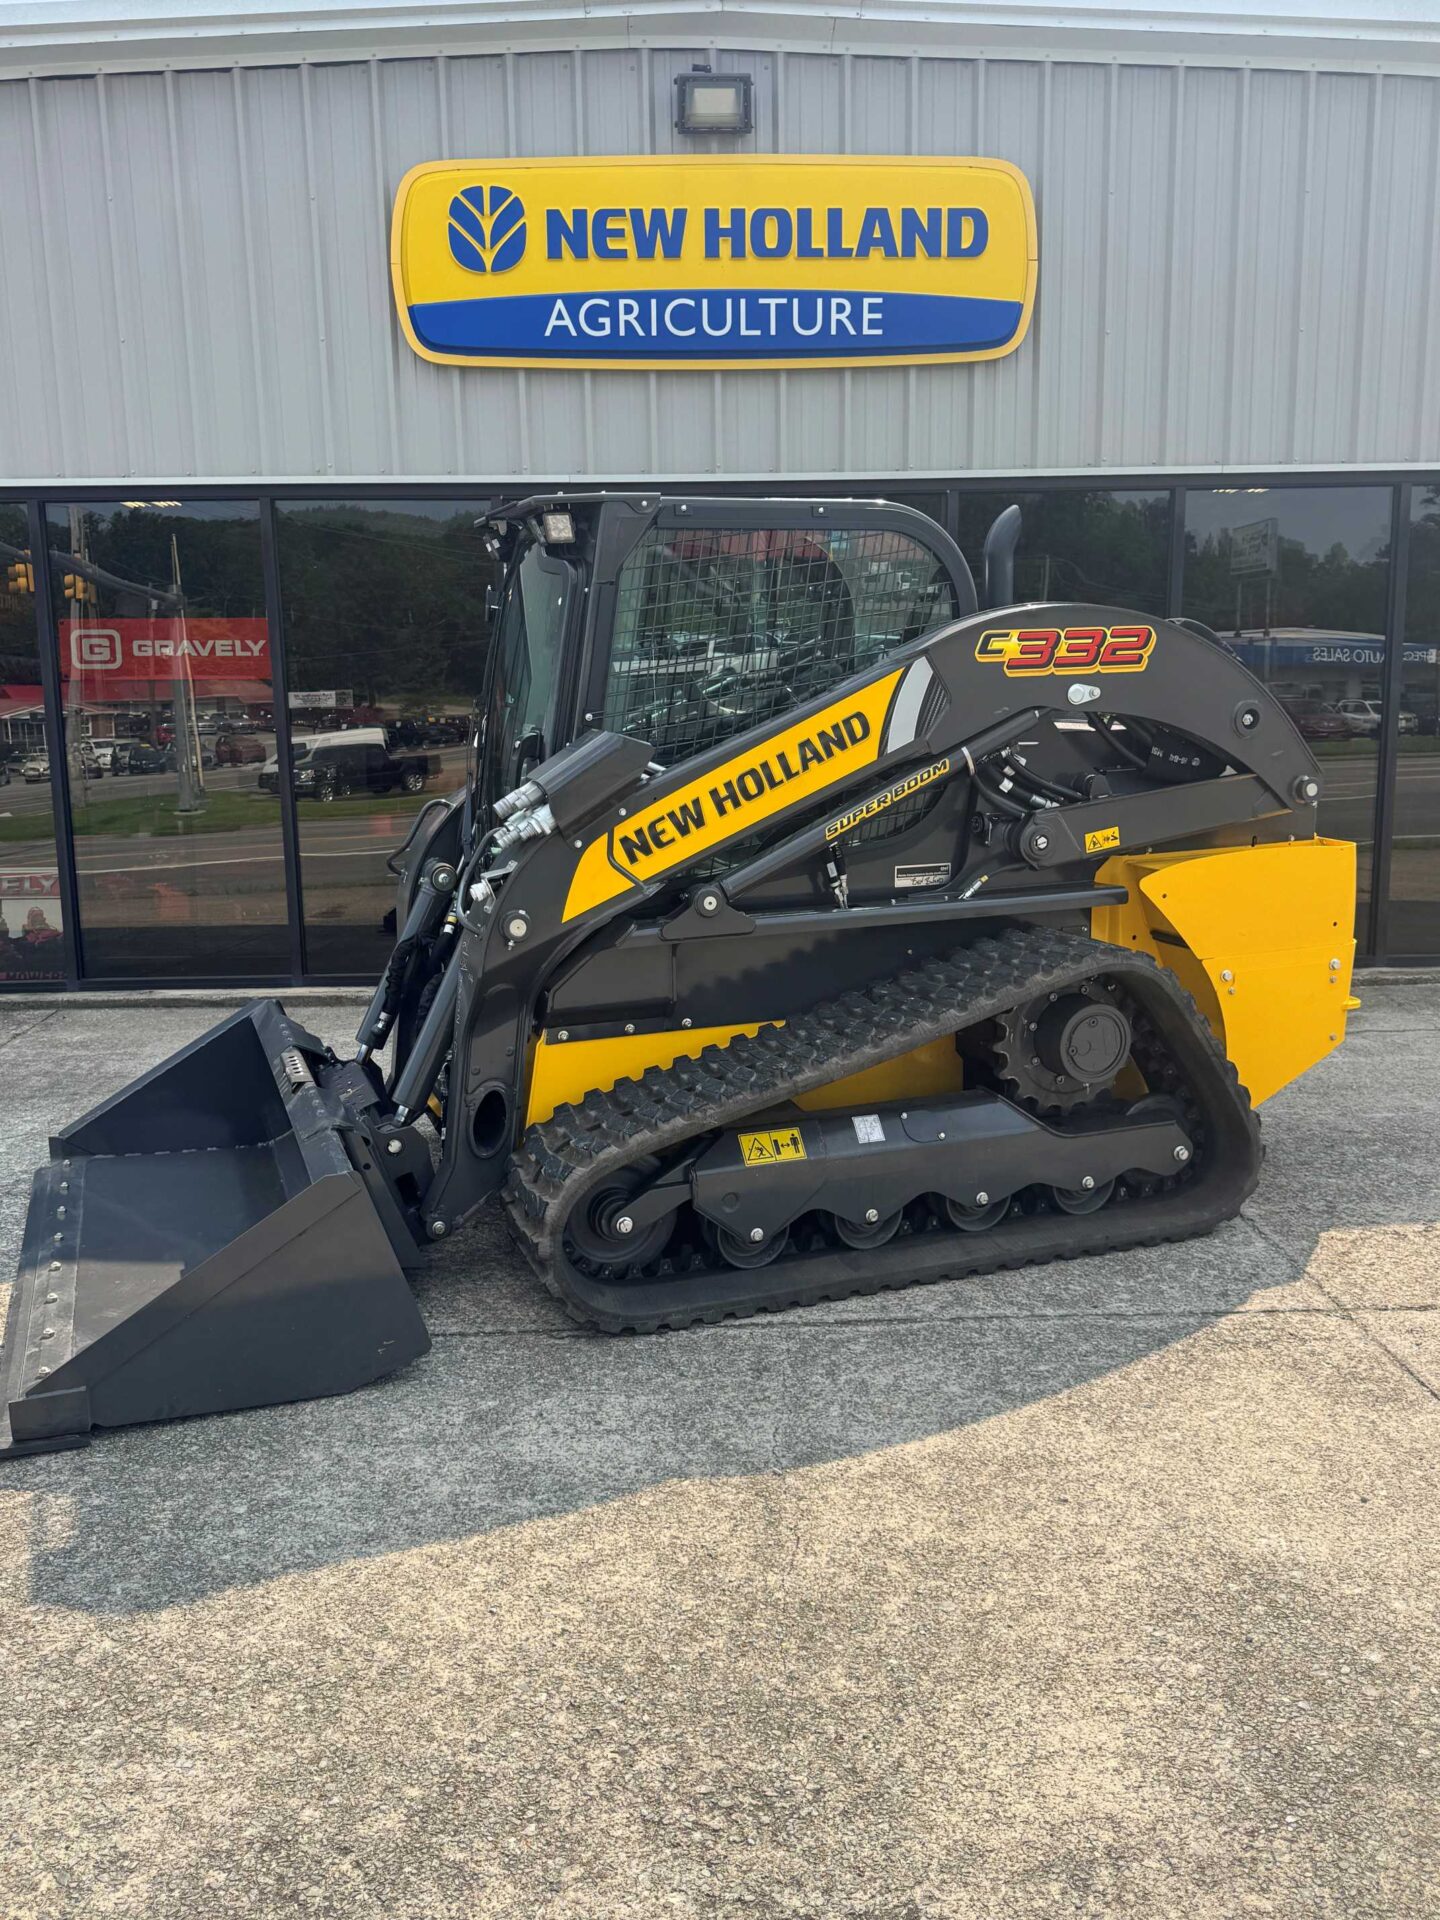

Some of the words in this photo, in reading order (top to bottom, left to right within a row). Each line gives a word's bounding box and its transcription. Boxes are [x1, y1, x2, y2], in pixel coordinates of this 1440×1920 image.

[546, 208, 688, 260] NEW
[704, 206, 990, 260] HOLLAND
[544, 297, 883, 337] AGRICULTURE
[132, 639, 266, 657] GRAVELY
[975, 625, 1157, 678] C332
[618, 797, 706, 866] NEW
[708, 711, 871, 818] HOLLAND
[825, 793, 890, 840] SUPER
[892, 758, 950, 801] BOOM
